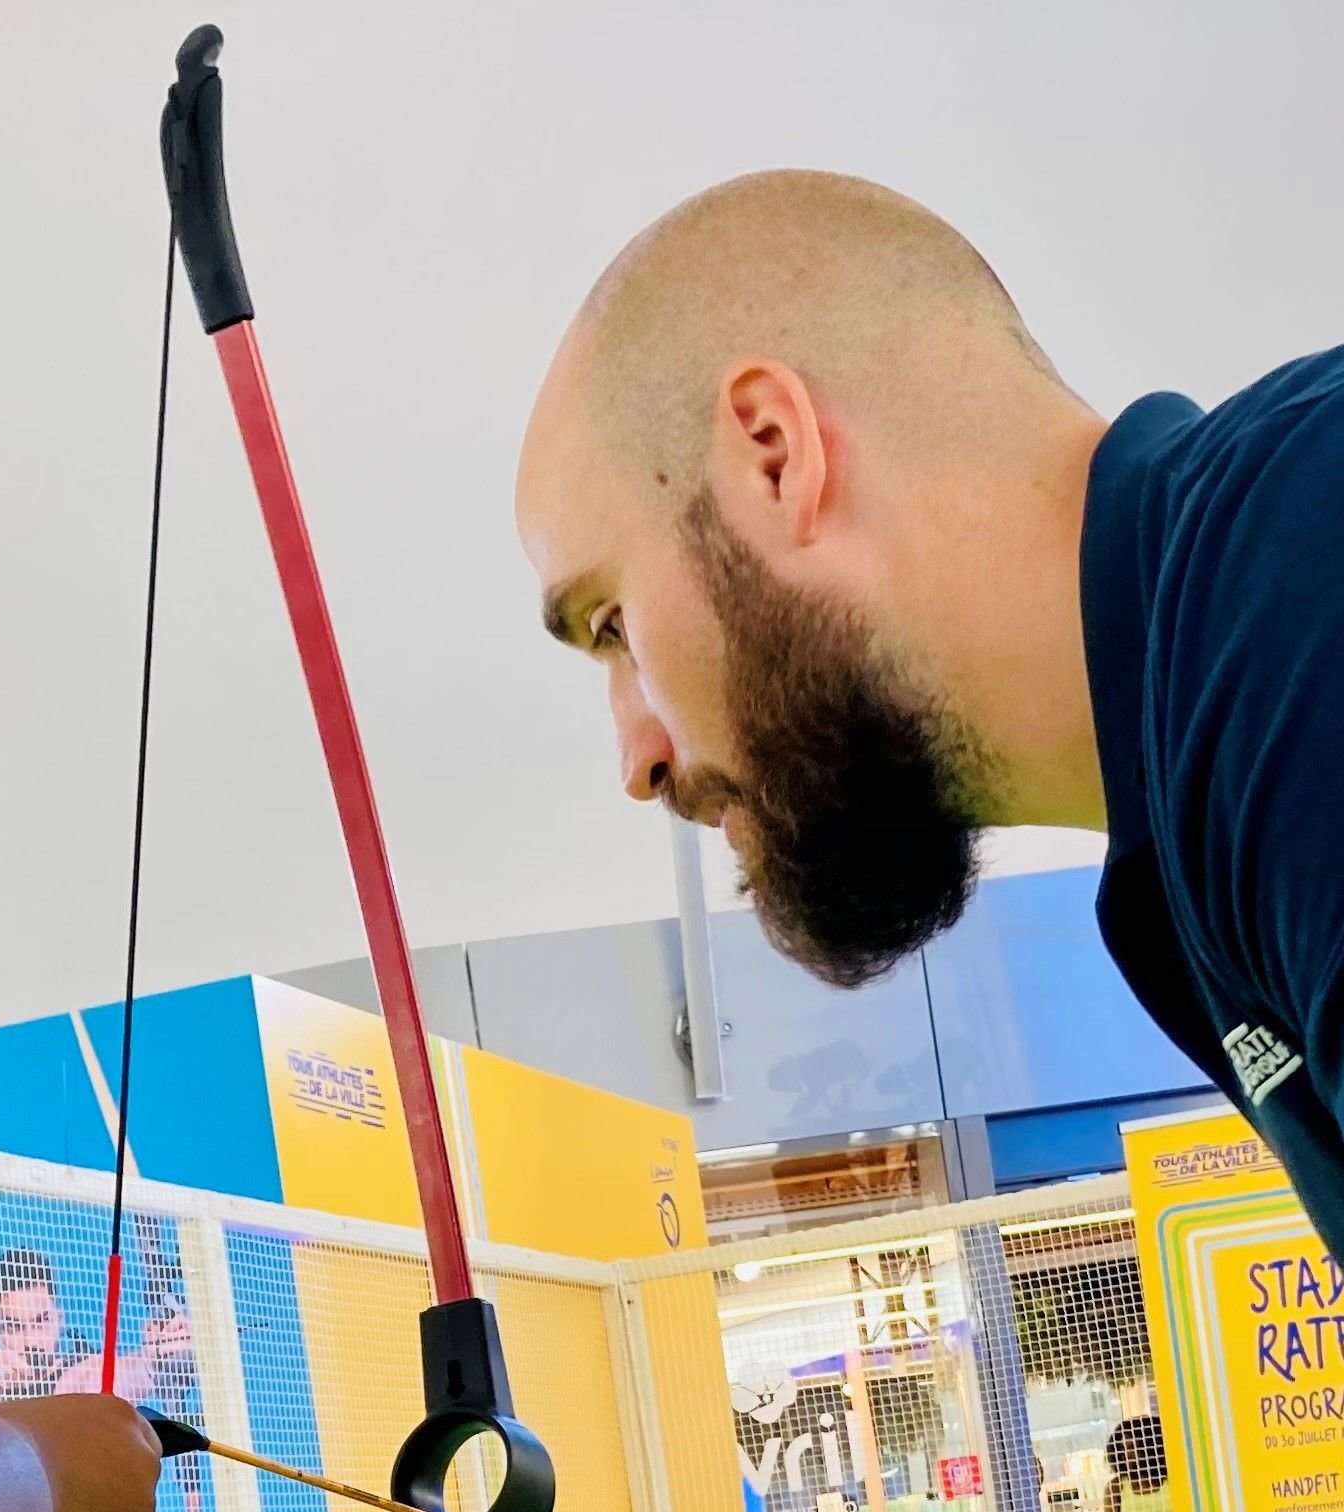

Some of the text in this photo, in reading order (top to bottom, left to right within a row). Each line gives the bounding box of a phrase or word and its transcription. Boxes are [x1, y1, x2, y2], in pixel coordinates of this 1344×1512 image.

[1153, 1154, 1188, 1169] TOUS
[1180, 1154, 1259, 1175] DE LA VILLE
[1282, 1433, 1295, 1446] 30
[1298, 1427, 1336, 1446] JUILLET
[1272, 1472, 1340, 1498] HANDFIT
